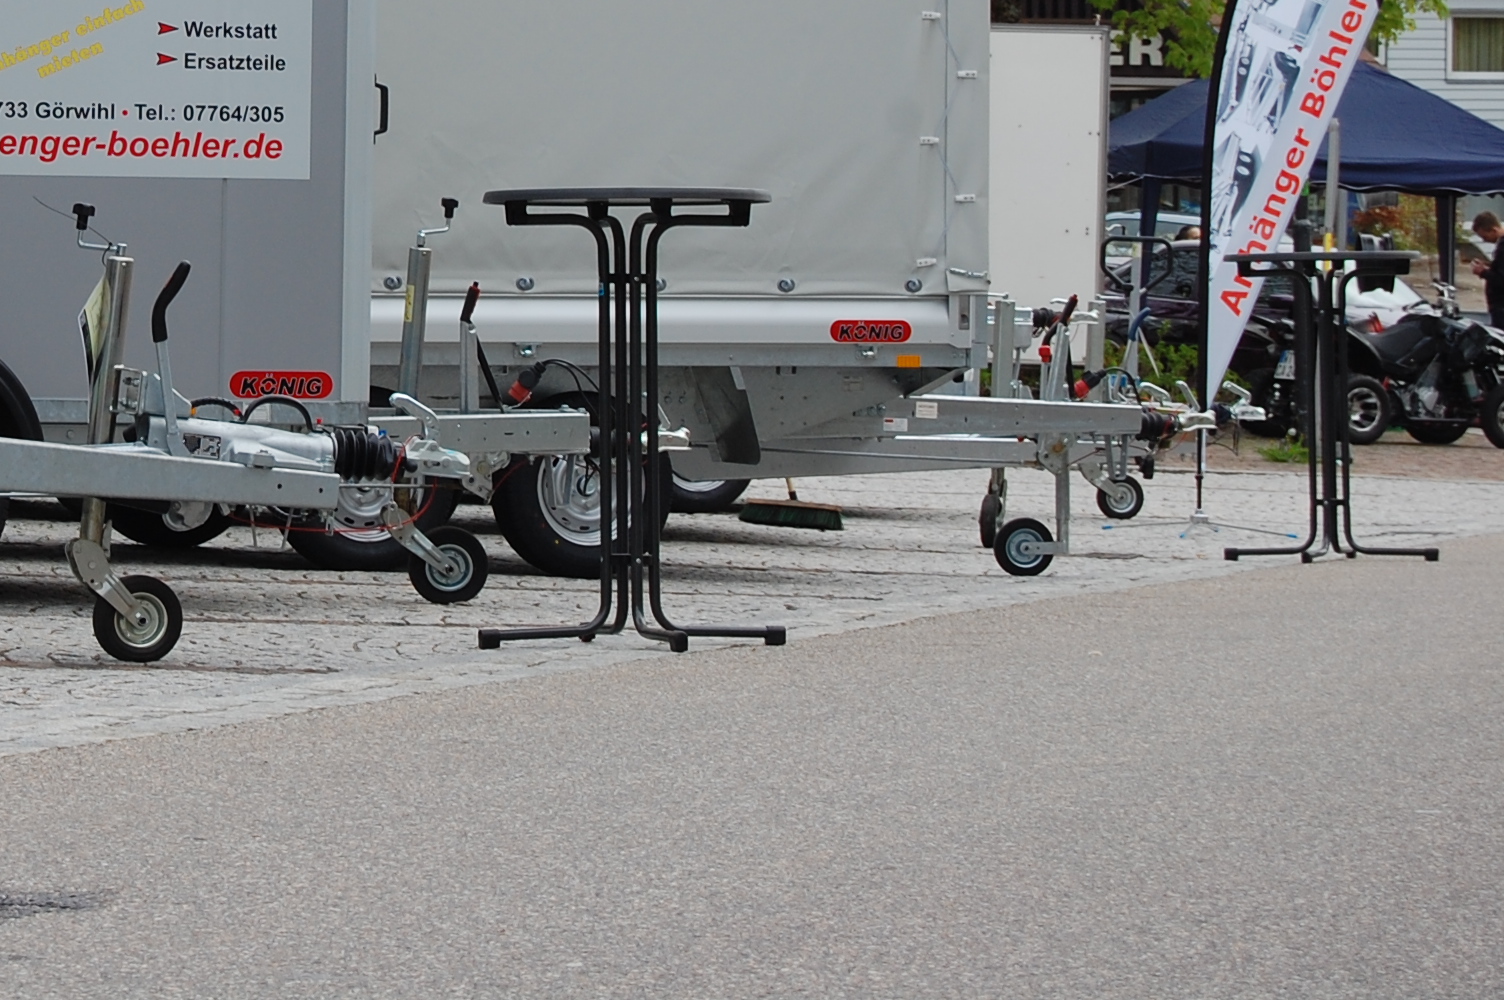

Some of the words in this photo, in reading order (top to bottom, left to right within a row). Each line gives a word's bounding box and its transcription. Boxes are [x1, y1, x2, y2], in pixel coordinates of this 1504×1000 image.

[184, 21, 278, 40] Werkstatt
[37, 42, 104, 78] mieten
[183, 53, 286, 72] Ersatzteile
[36, 102, 115, 122] Görwihl
[135, 104, 176, 122] Tel.:
[183, 106, 284, 123] 07764/305
[838, 321, 903, 341] KÖNIG
[240, 373, 322, 396] KÖNIG
